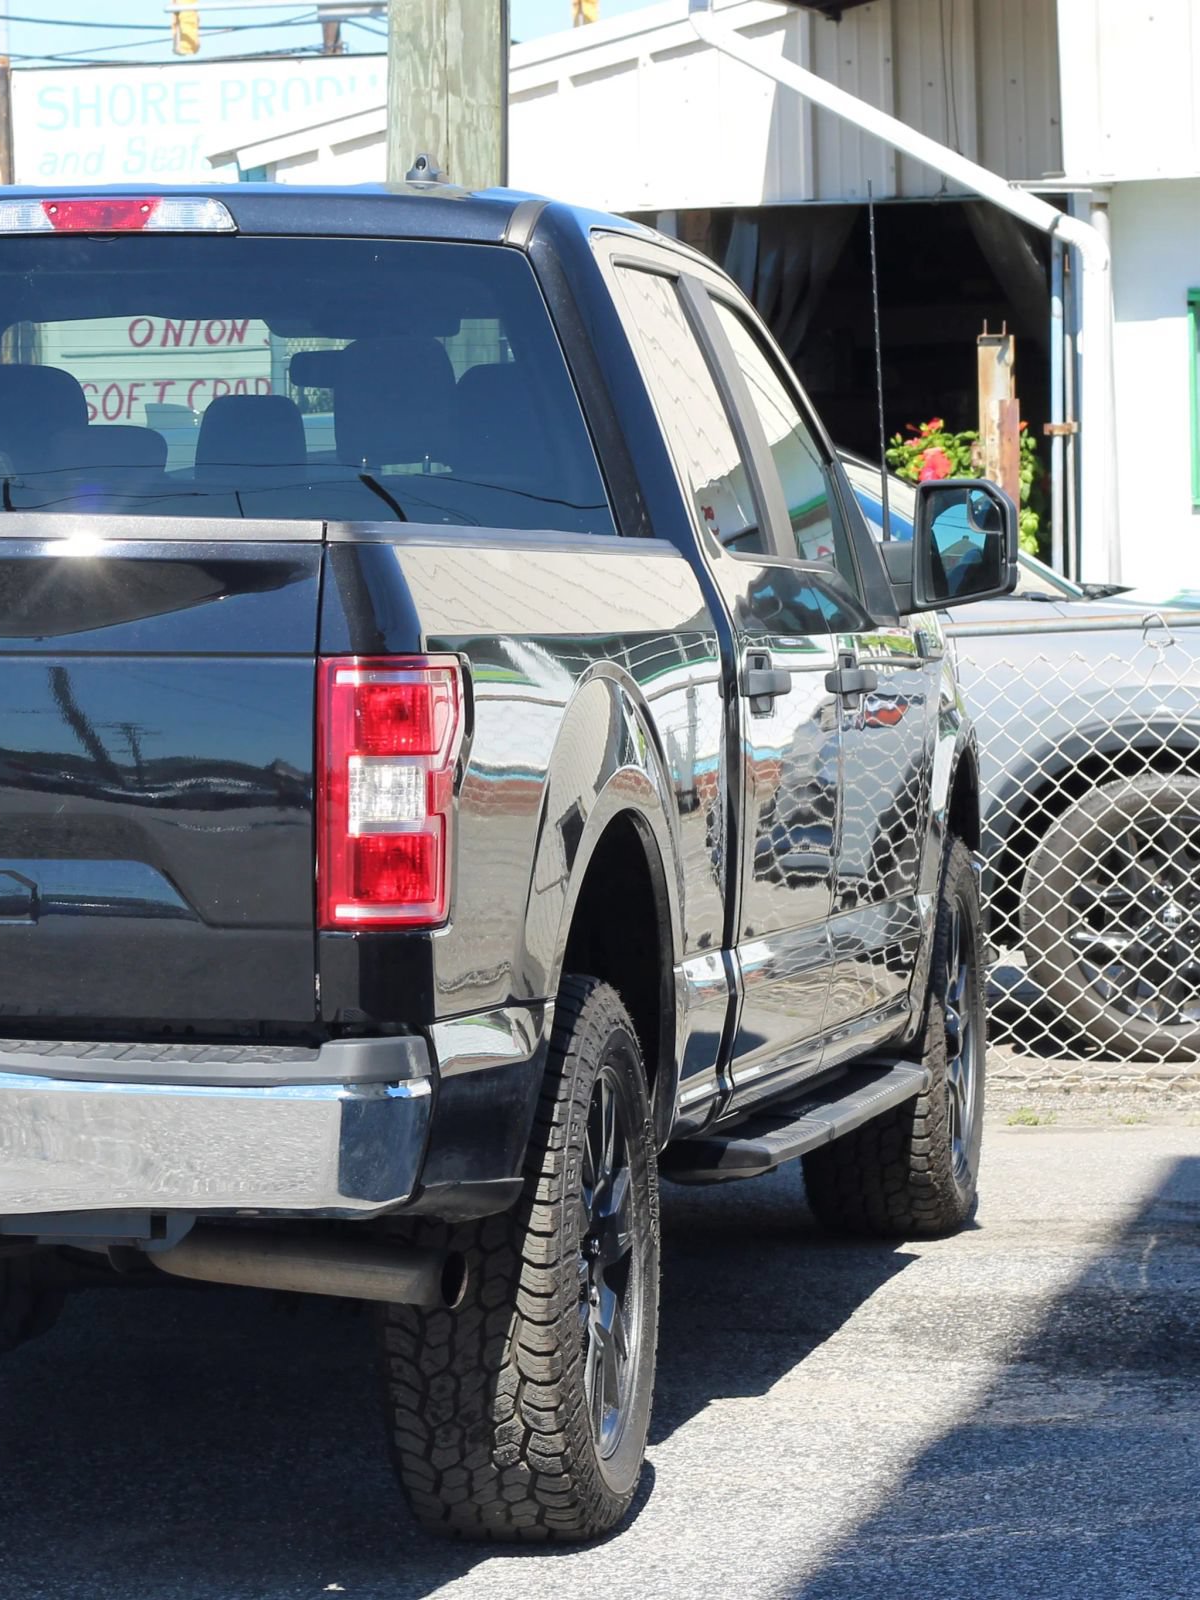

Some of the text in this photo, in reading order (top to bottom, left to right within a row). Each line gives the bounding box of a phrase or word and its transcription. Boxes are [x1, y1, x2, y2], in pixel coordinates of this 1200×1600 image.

[36, 80, 200, 131] SHORE
[38, 144, 104, 176] and
[81, 380, 176, 421] SOFT
